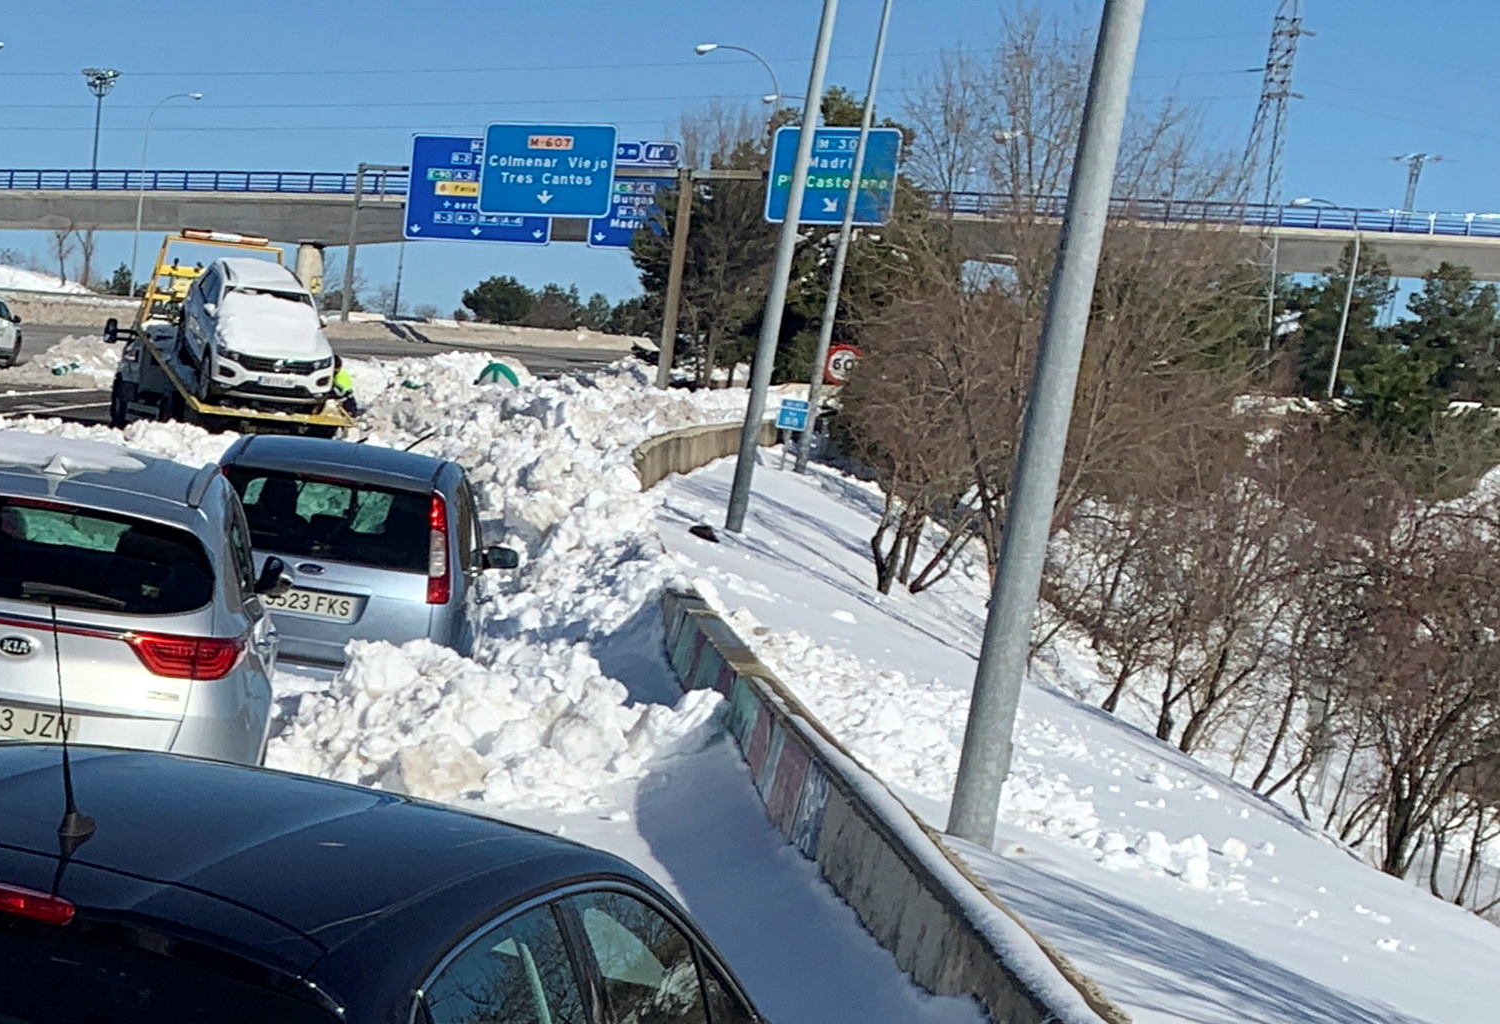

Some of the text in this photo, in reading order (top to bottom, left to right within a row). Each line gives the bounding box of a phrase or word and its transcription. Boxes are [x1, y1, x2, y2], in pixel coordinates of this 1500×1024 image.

[529, 138, 572, 149] M-607
[489, 155, 559, 167] Colmenar
[568, 156, 608, 172] Viejo
[808, 157, 854, 169] Madri
[501, 172, 593, 186] Tres Cantos
[613, 194, 654, 206] Burgos
[832, 358, 853, 371] 60
[315, 596, 350, 616] FKS
[2, 639, 31, 653] KIA
[23, 712, 72, 739] JZN
